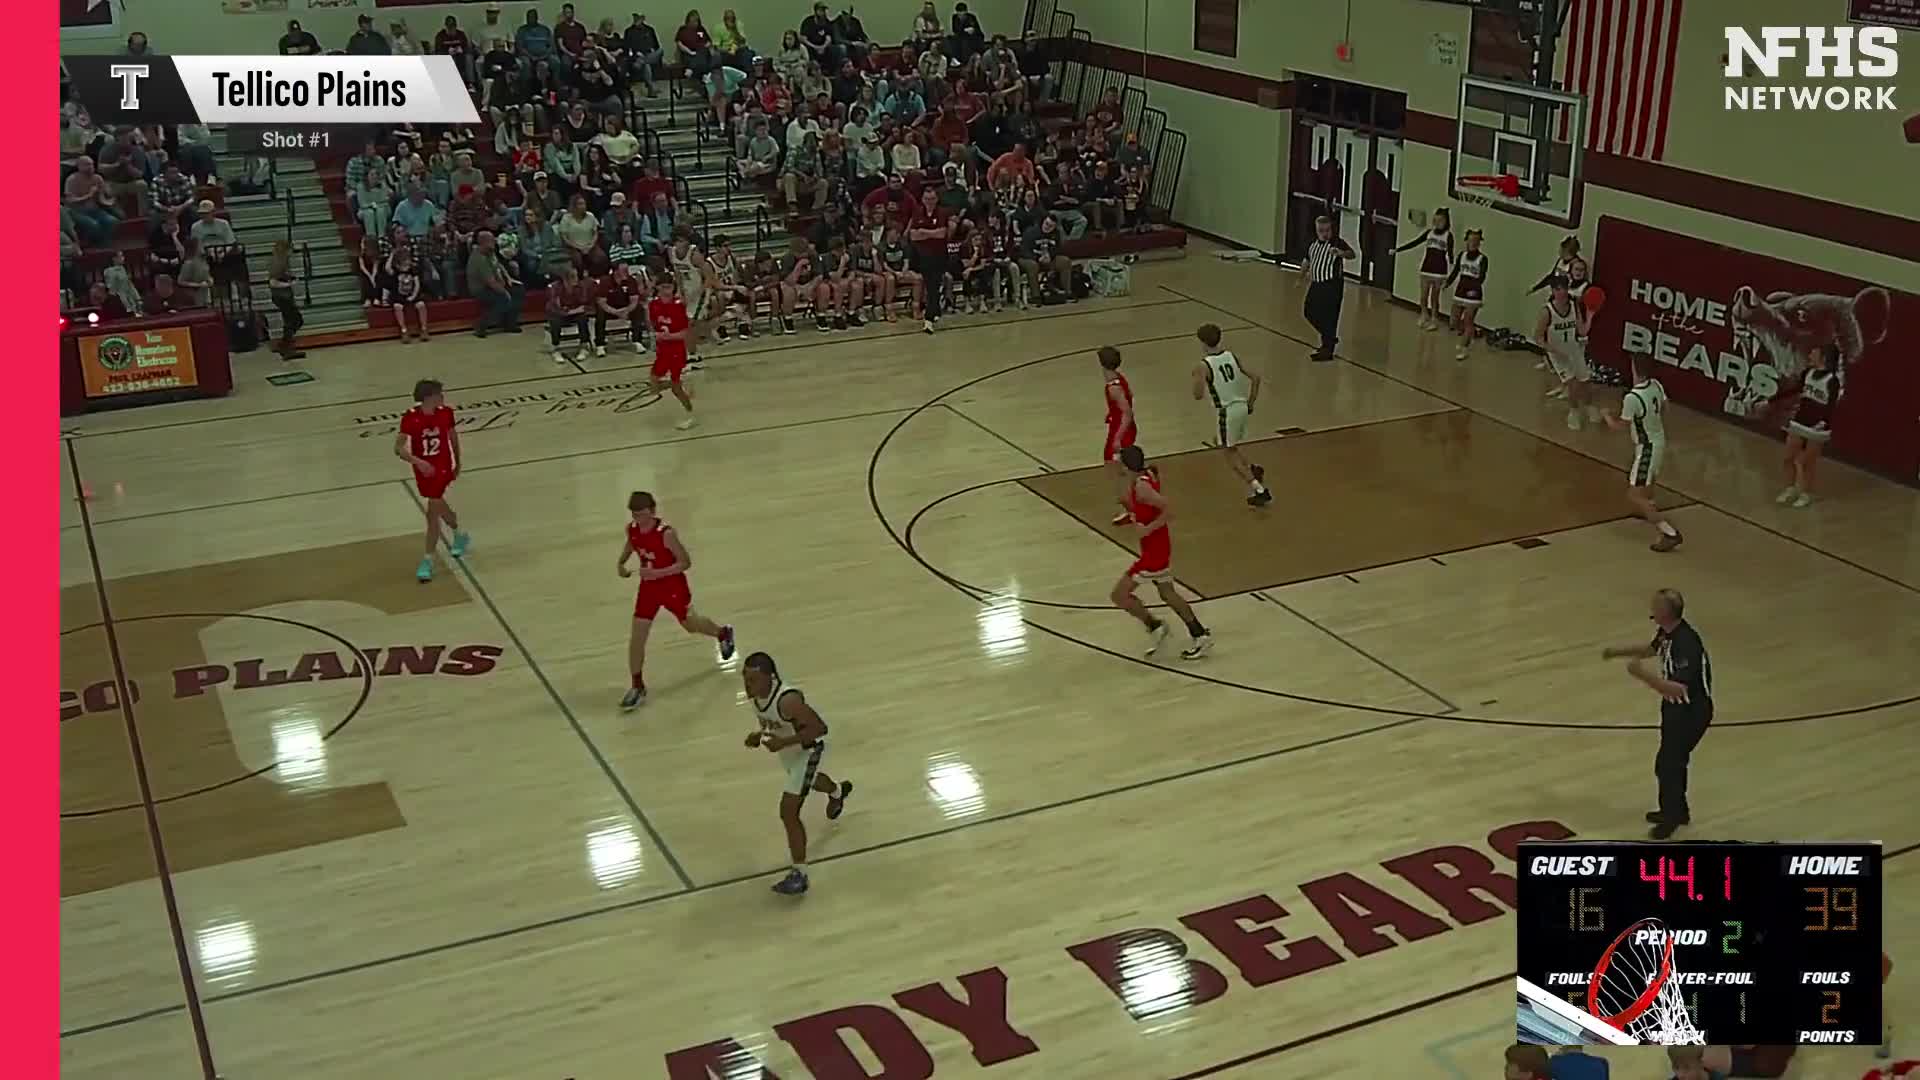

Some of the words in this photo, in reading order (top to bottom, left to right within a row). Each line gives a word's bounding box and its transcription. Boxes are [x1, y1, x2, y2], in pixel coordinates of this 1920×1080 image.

[1630, 279, 1727, 326] HOME
[1218, 362, 1234, 383] 10
[1622, 321, 1779, 399] BEARS
[422, 438, 441, 456] 12
[173, 645, 503, 698] PLAINS
[1530, 856, 1614, 875] GUEST
[1640, 856, 1732, 901] 44.1
[1789, 856, 1863, 875] HOME
[1568, 887, 1604, 931] 16
[1803, 887, 1857, 931] 39
[1722, 920, 1743, 954] 2
[1801, 971, 1850, 984] FOULS
[1821, 991, 1841, 1024] 2
[1799, 1030, 1855, 1043] POINTS
